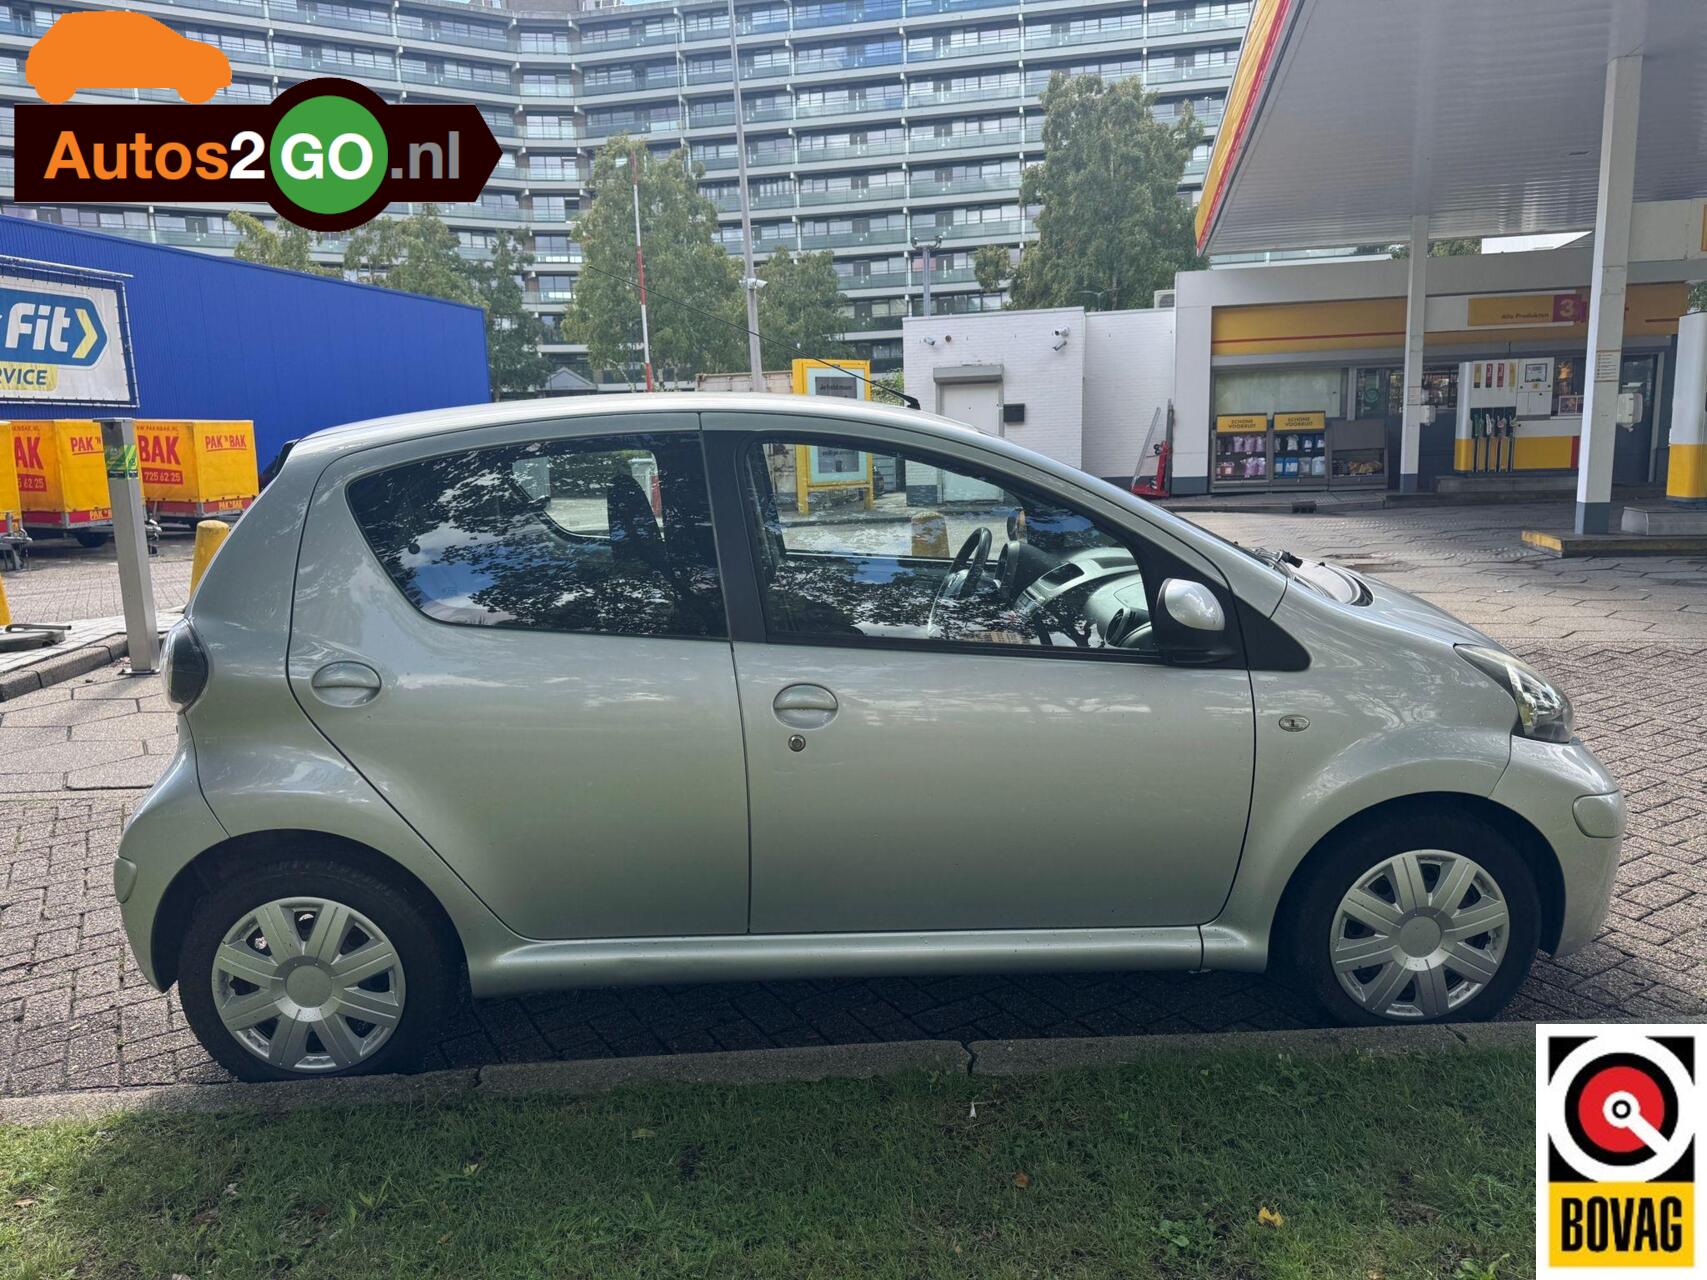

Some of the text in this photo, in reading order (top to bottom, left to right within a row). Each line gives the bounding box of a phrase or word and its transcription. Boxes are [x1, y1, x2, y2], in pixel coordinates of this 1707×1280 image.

[70, 437, 94, 452] PAK
[137, 435, 181, 465] BAK
[205, 435, 223, 450] PAK
[229, 434, 247, 449] BAK
